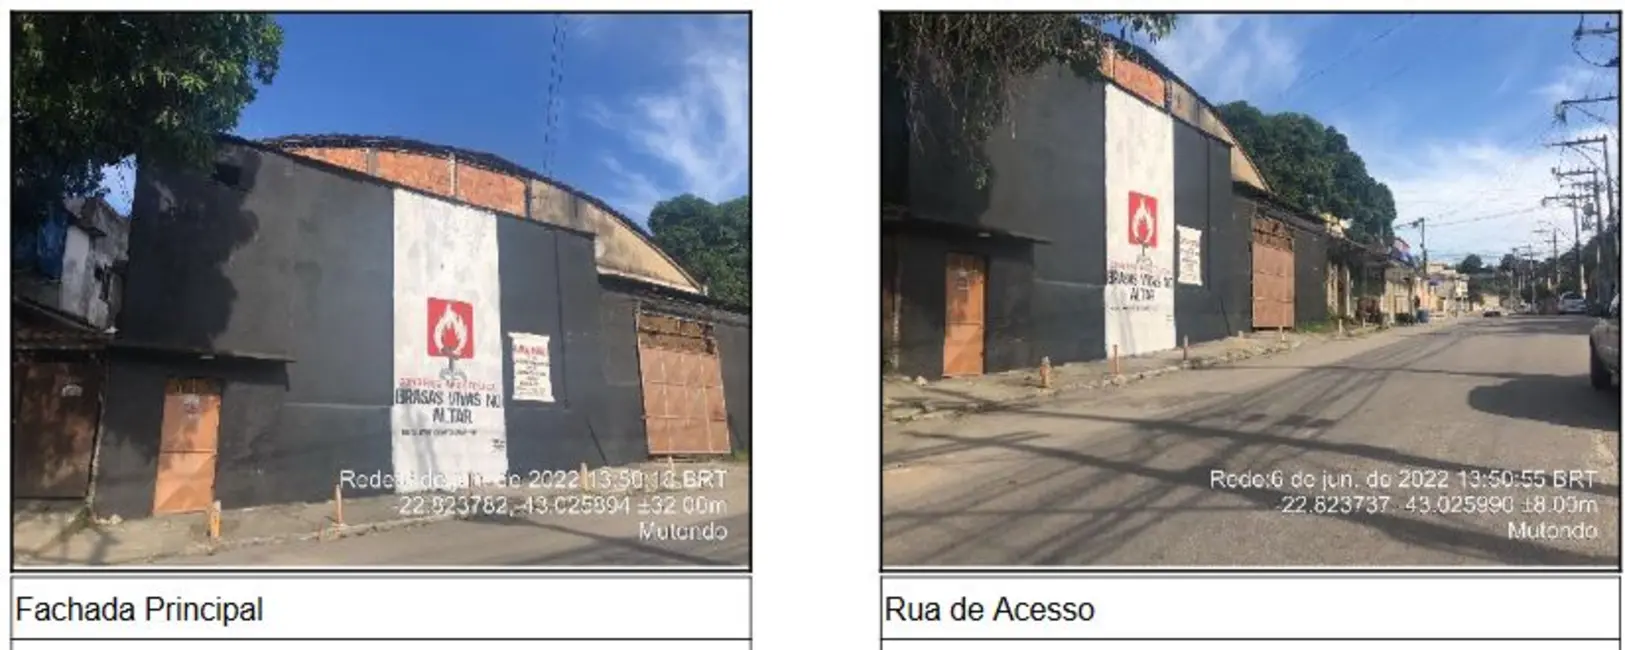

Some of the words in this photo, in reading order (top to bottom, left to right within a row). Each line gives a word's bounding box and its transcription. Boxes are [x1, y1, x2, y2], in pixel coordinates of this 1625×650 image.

[395, 388, 444, 406] BRASAS
[448, 391, 481, 407] VIVAS
[432, 407, 473, 424] ALTAR
